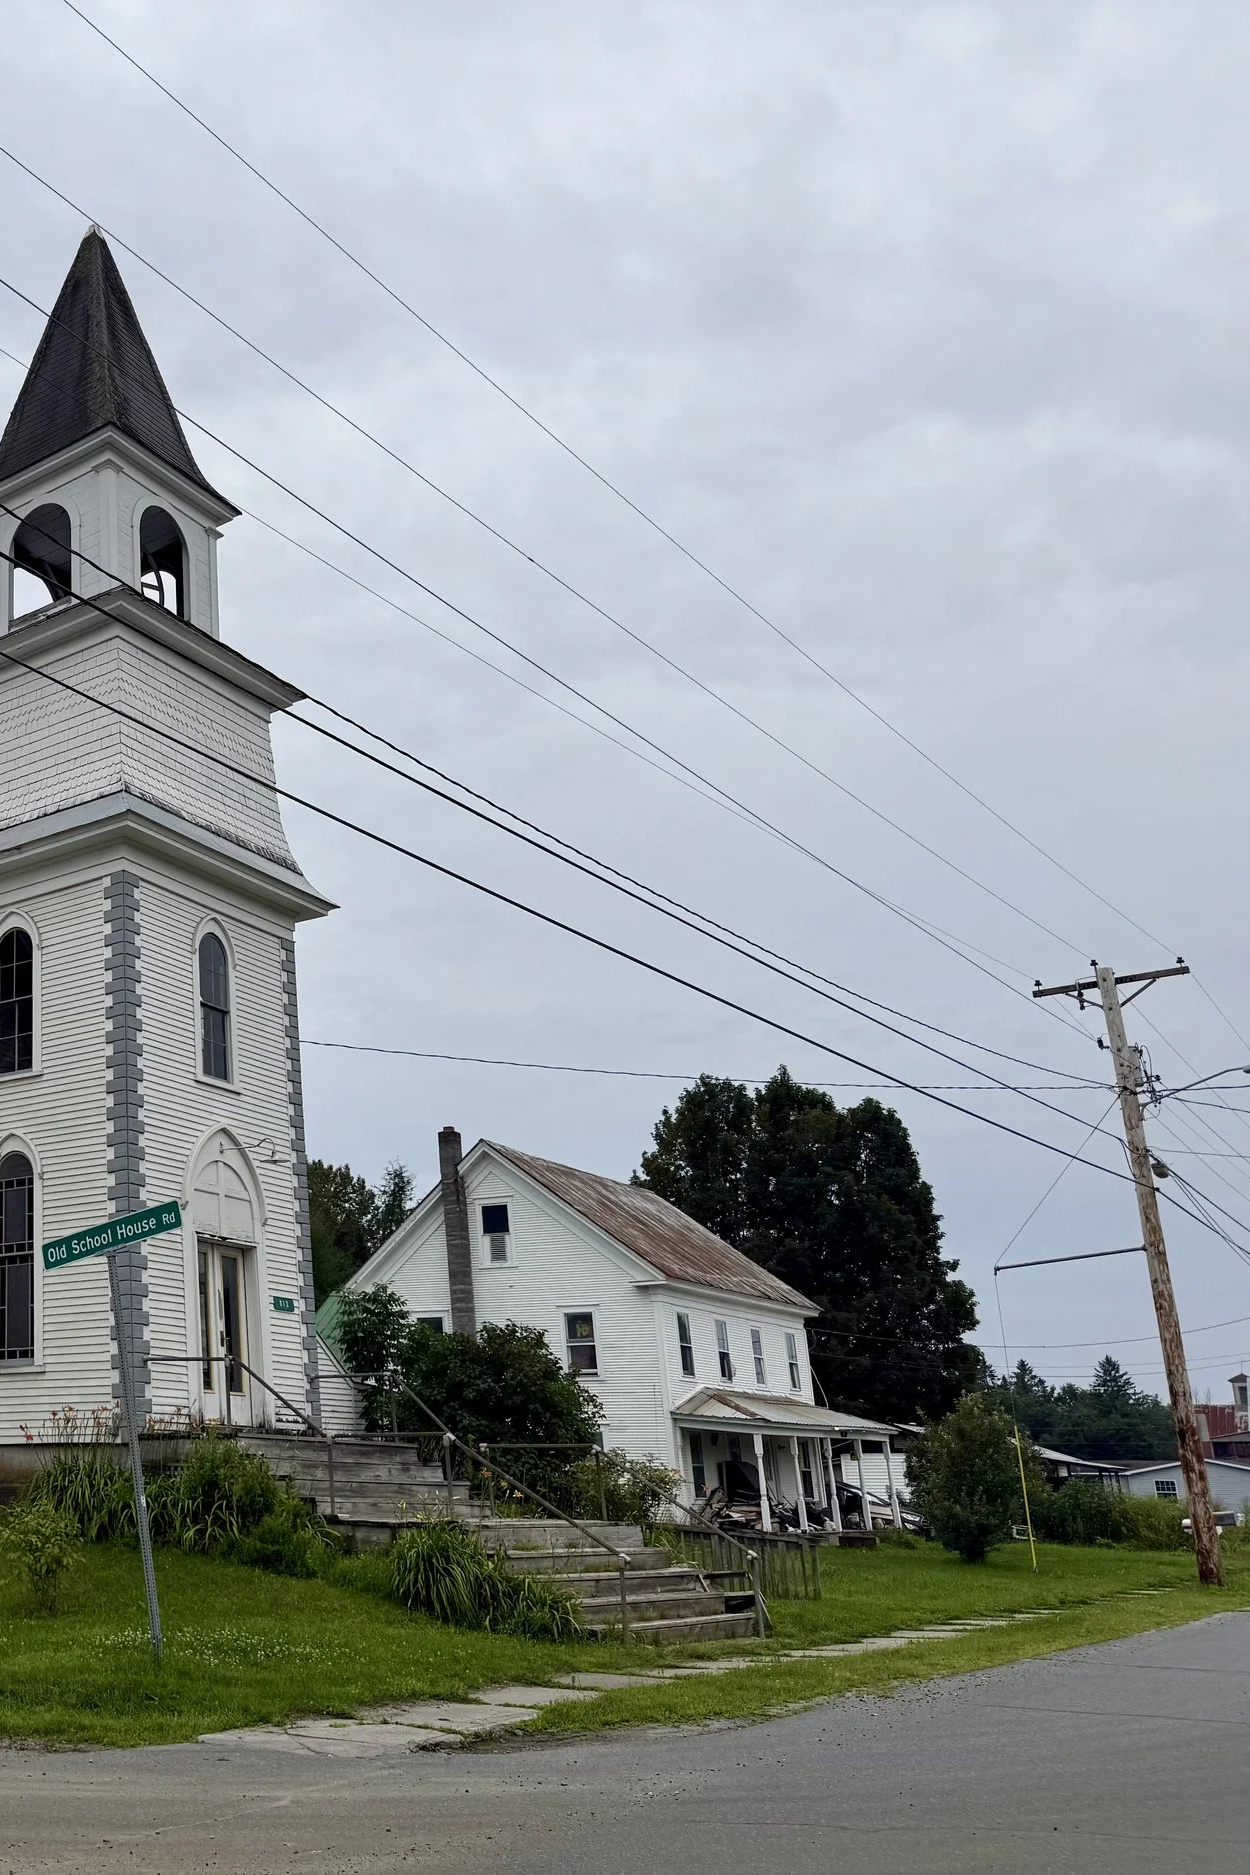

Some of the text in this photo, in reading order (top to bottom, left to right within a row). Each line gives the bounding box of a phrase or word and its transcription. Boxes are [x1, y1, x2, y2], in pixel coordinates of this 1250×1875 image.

[47, 1211, 176, 1262] Old School House Rd
